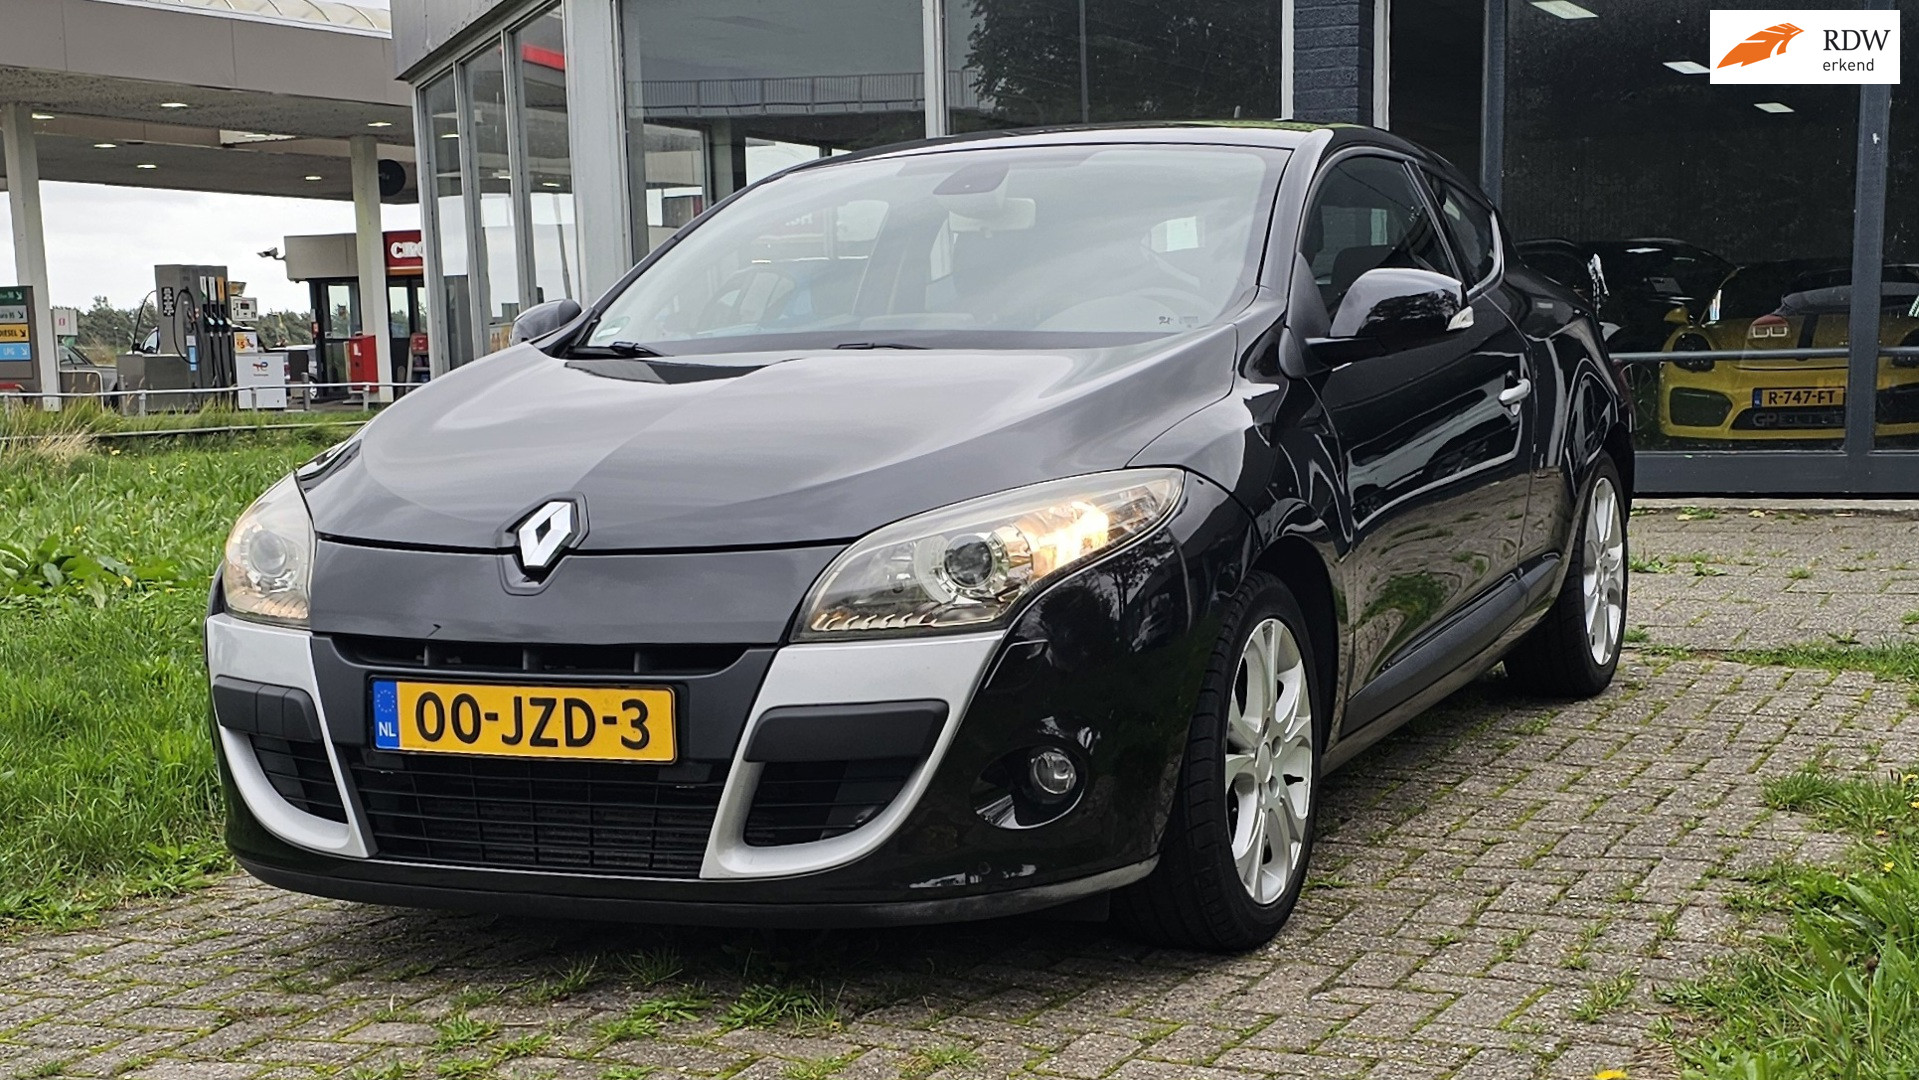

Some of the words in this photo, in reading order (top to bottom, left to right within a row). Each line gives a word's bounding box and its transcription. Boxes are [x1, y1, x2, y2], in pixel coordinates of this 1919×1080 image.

[1768, 390, 1835, 405] R-747-FT
[378, 722, 396, 738] NL
[415, 691, 650, 750] 00-JZD-3
